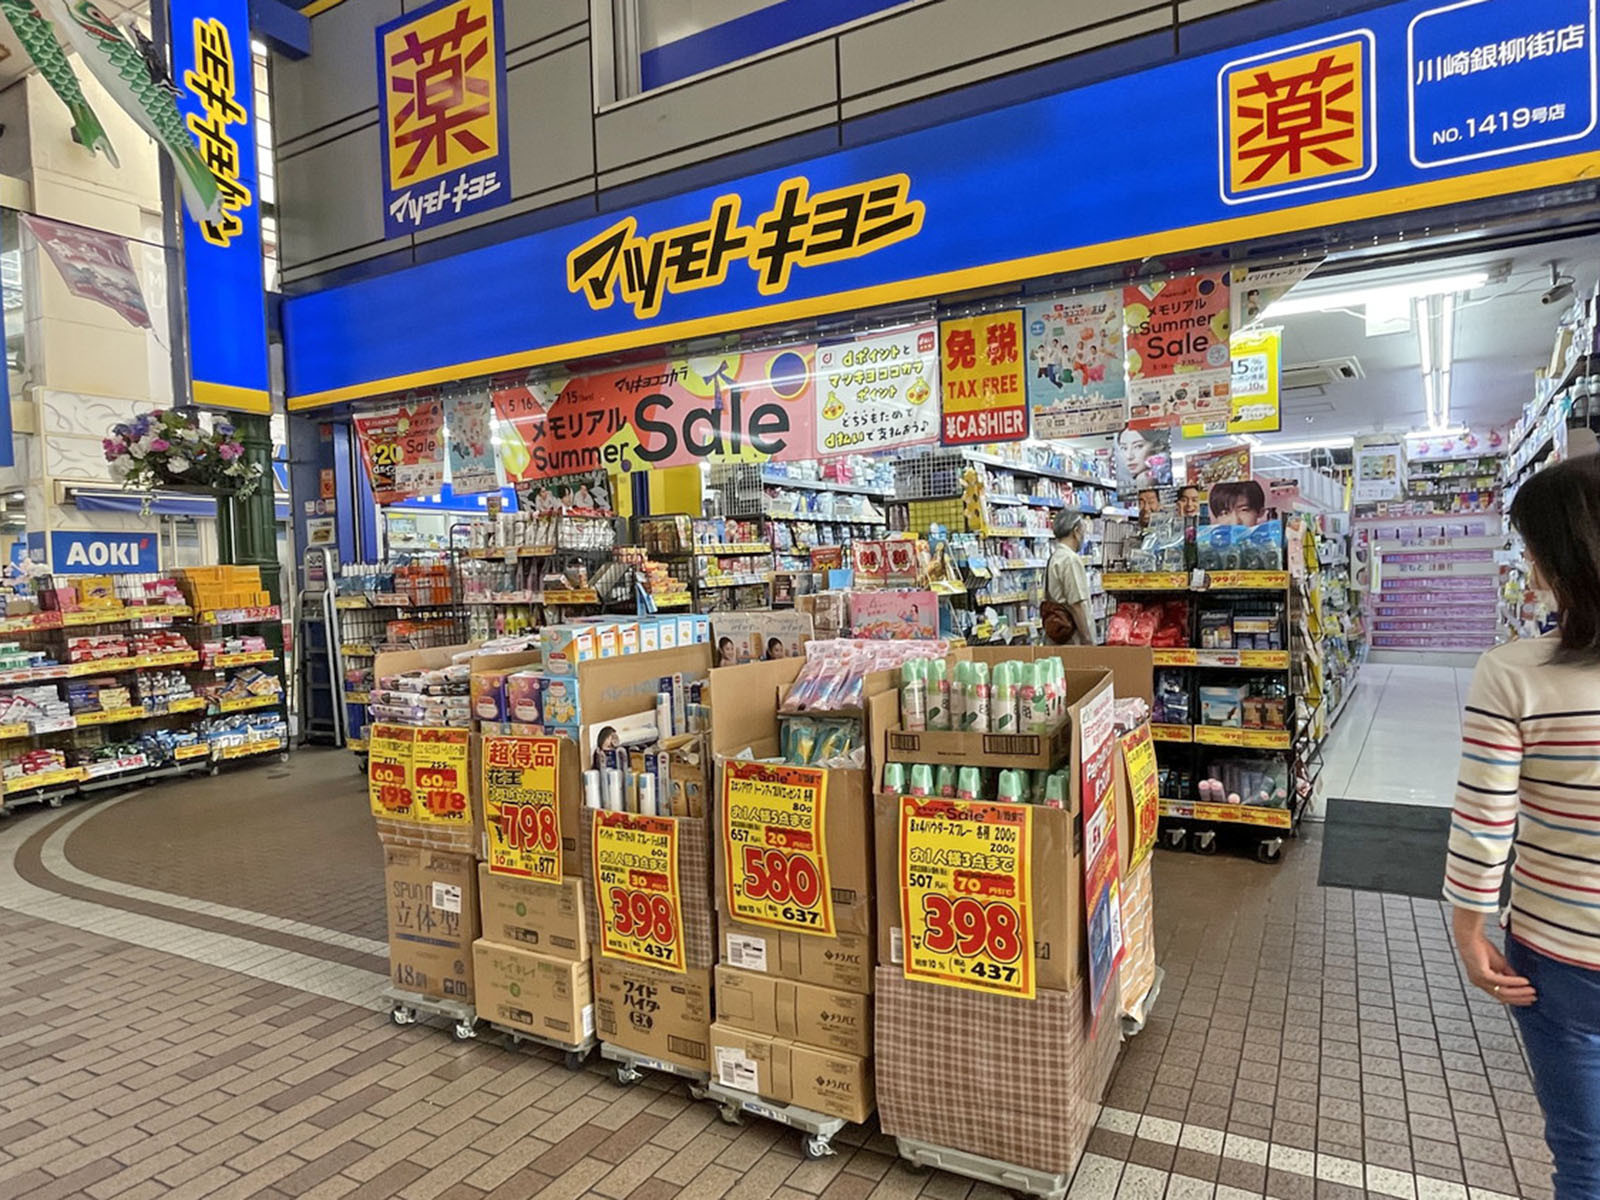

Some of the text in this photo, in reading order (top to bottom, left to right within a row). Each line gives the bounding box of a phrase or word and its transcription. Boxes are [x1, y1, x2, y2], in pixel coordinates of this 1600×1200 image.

[1416, 24, 1586, 85] 川崎銀柳街店
[390, 6, 489, 180] 薬
[1236, 54, 1355, 185] 薬
[389, 171, 501, 226] マツモトキヨシ
[570, 181, 920, 313] マツモトキヨシ
[1147, 297, 1206, 318] メモリアル
[1139, 313, 1216, 336] Summer
[946, 322, 1018, 371] 免税
[1147, 332, 1209, 359] Sale
[856, 385, 898, 402] ポイント
[948, 374, 1018, 400] TAX FREE
[532, 406, 629, 443] メモリアル
[633, 383, 791, 463] Sale
[406, 438, 436, 454] Sale
[531, 440, 630, 472] Summer
[66, 541, 139, 567] AOKI
[489, 743, 555, 767] 超得品
[375, 769, 395, 782] 60
[420, 774, 444, 787] 60
[488, 769, 522, 786] 花王
[758, 770, 788, 784] Sale
[501, 801, 559, 851] 798
[946, 808, 985, 823] Sale
[731, 828, 749, 843] 657
[768, 832, 787, 845] 20
[995, 826, 1016, 843] 200g
[909, 847, 1015, 873] お1人様3点まで
[743, 845, 820, 909] 580
[909, 874, 933, 889] 507
[957, 876, 981, 891] 70
[394, 900, 462, 938] 立体型
[610, 888, 674, 945] 398
[782, 907, 819, 924] 637
[923, 893, 1022, 963] 398
[644, 943, 673, 960] 437
[970, 962, 1017, 983] 437
[623, 979, 658, 999] ワイド
[633, 1011, 650, 1029] EX
